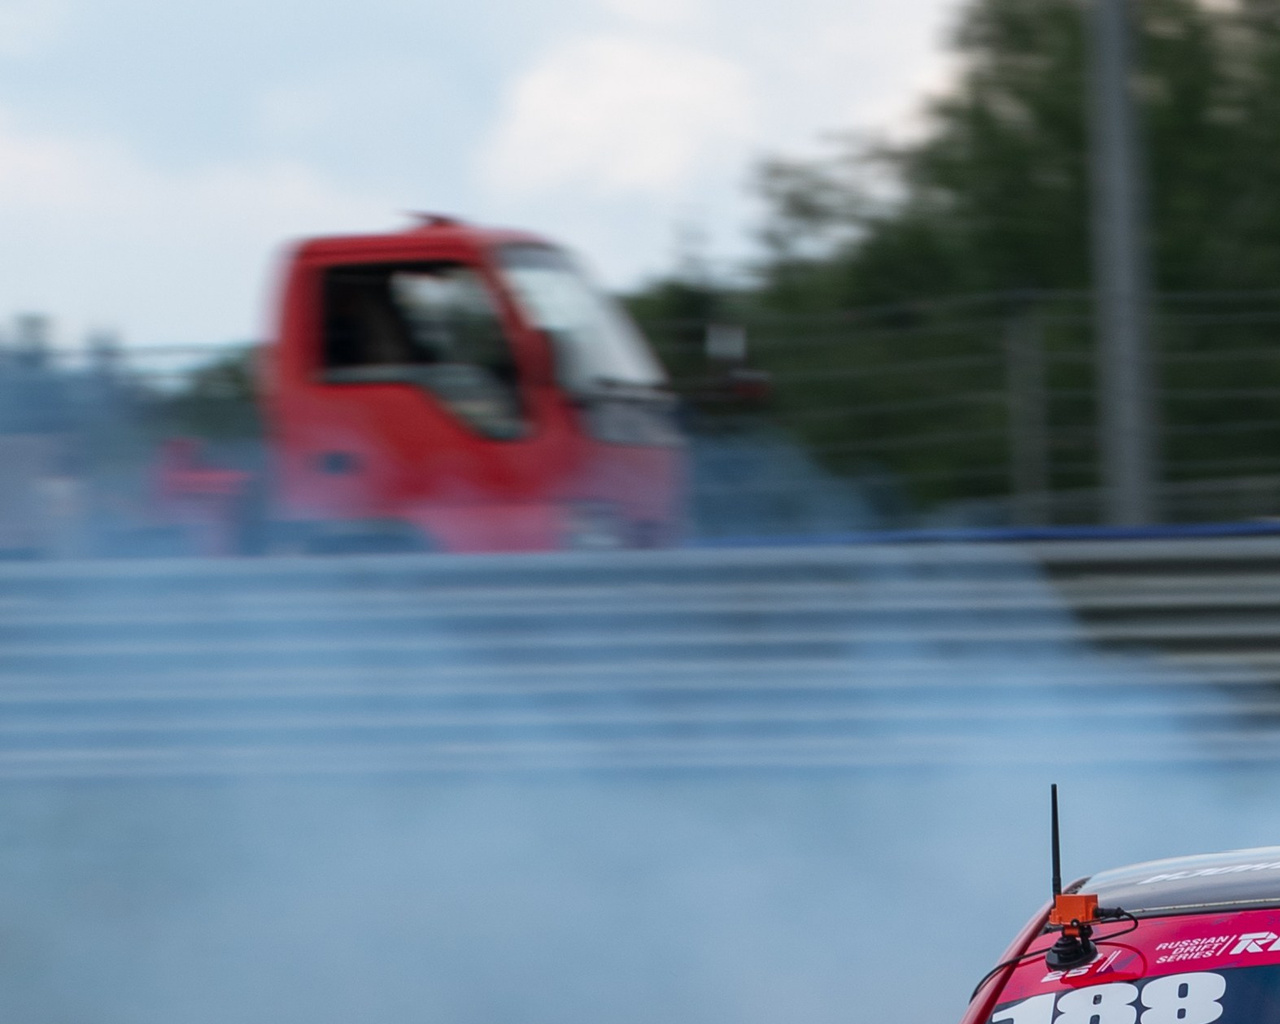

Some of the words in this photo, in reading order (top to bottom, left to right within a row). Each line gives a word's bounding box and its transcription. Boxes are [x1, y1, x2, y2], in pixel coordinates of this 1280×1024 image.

[1155, 935, 1230, 951] RUSSIAN
[1172, 942, 1223, 956] DRIFT
[1155, 949, 1215, 964] SERIES
